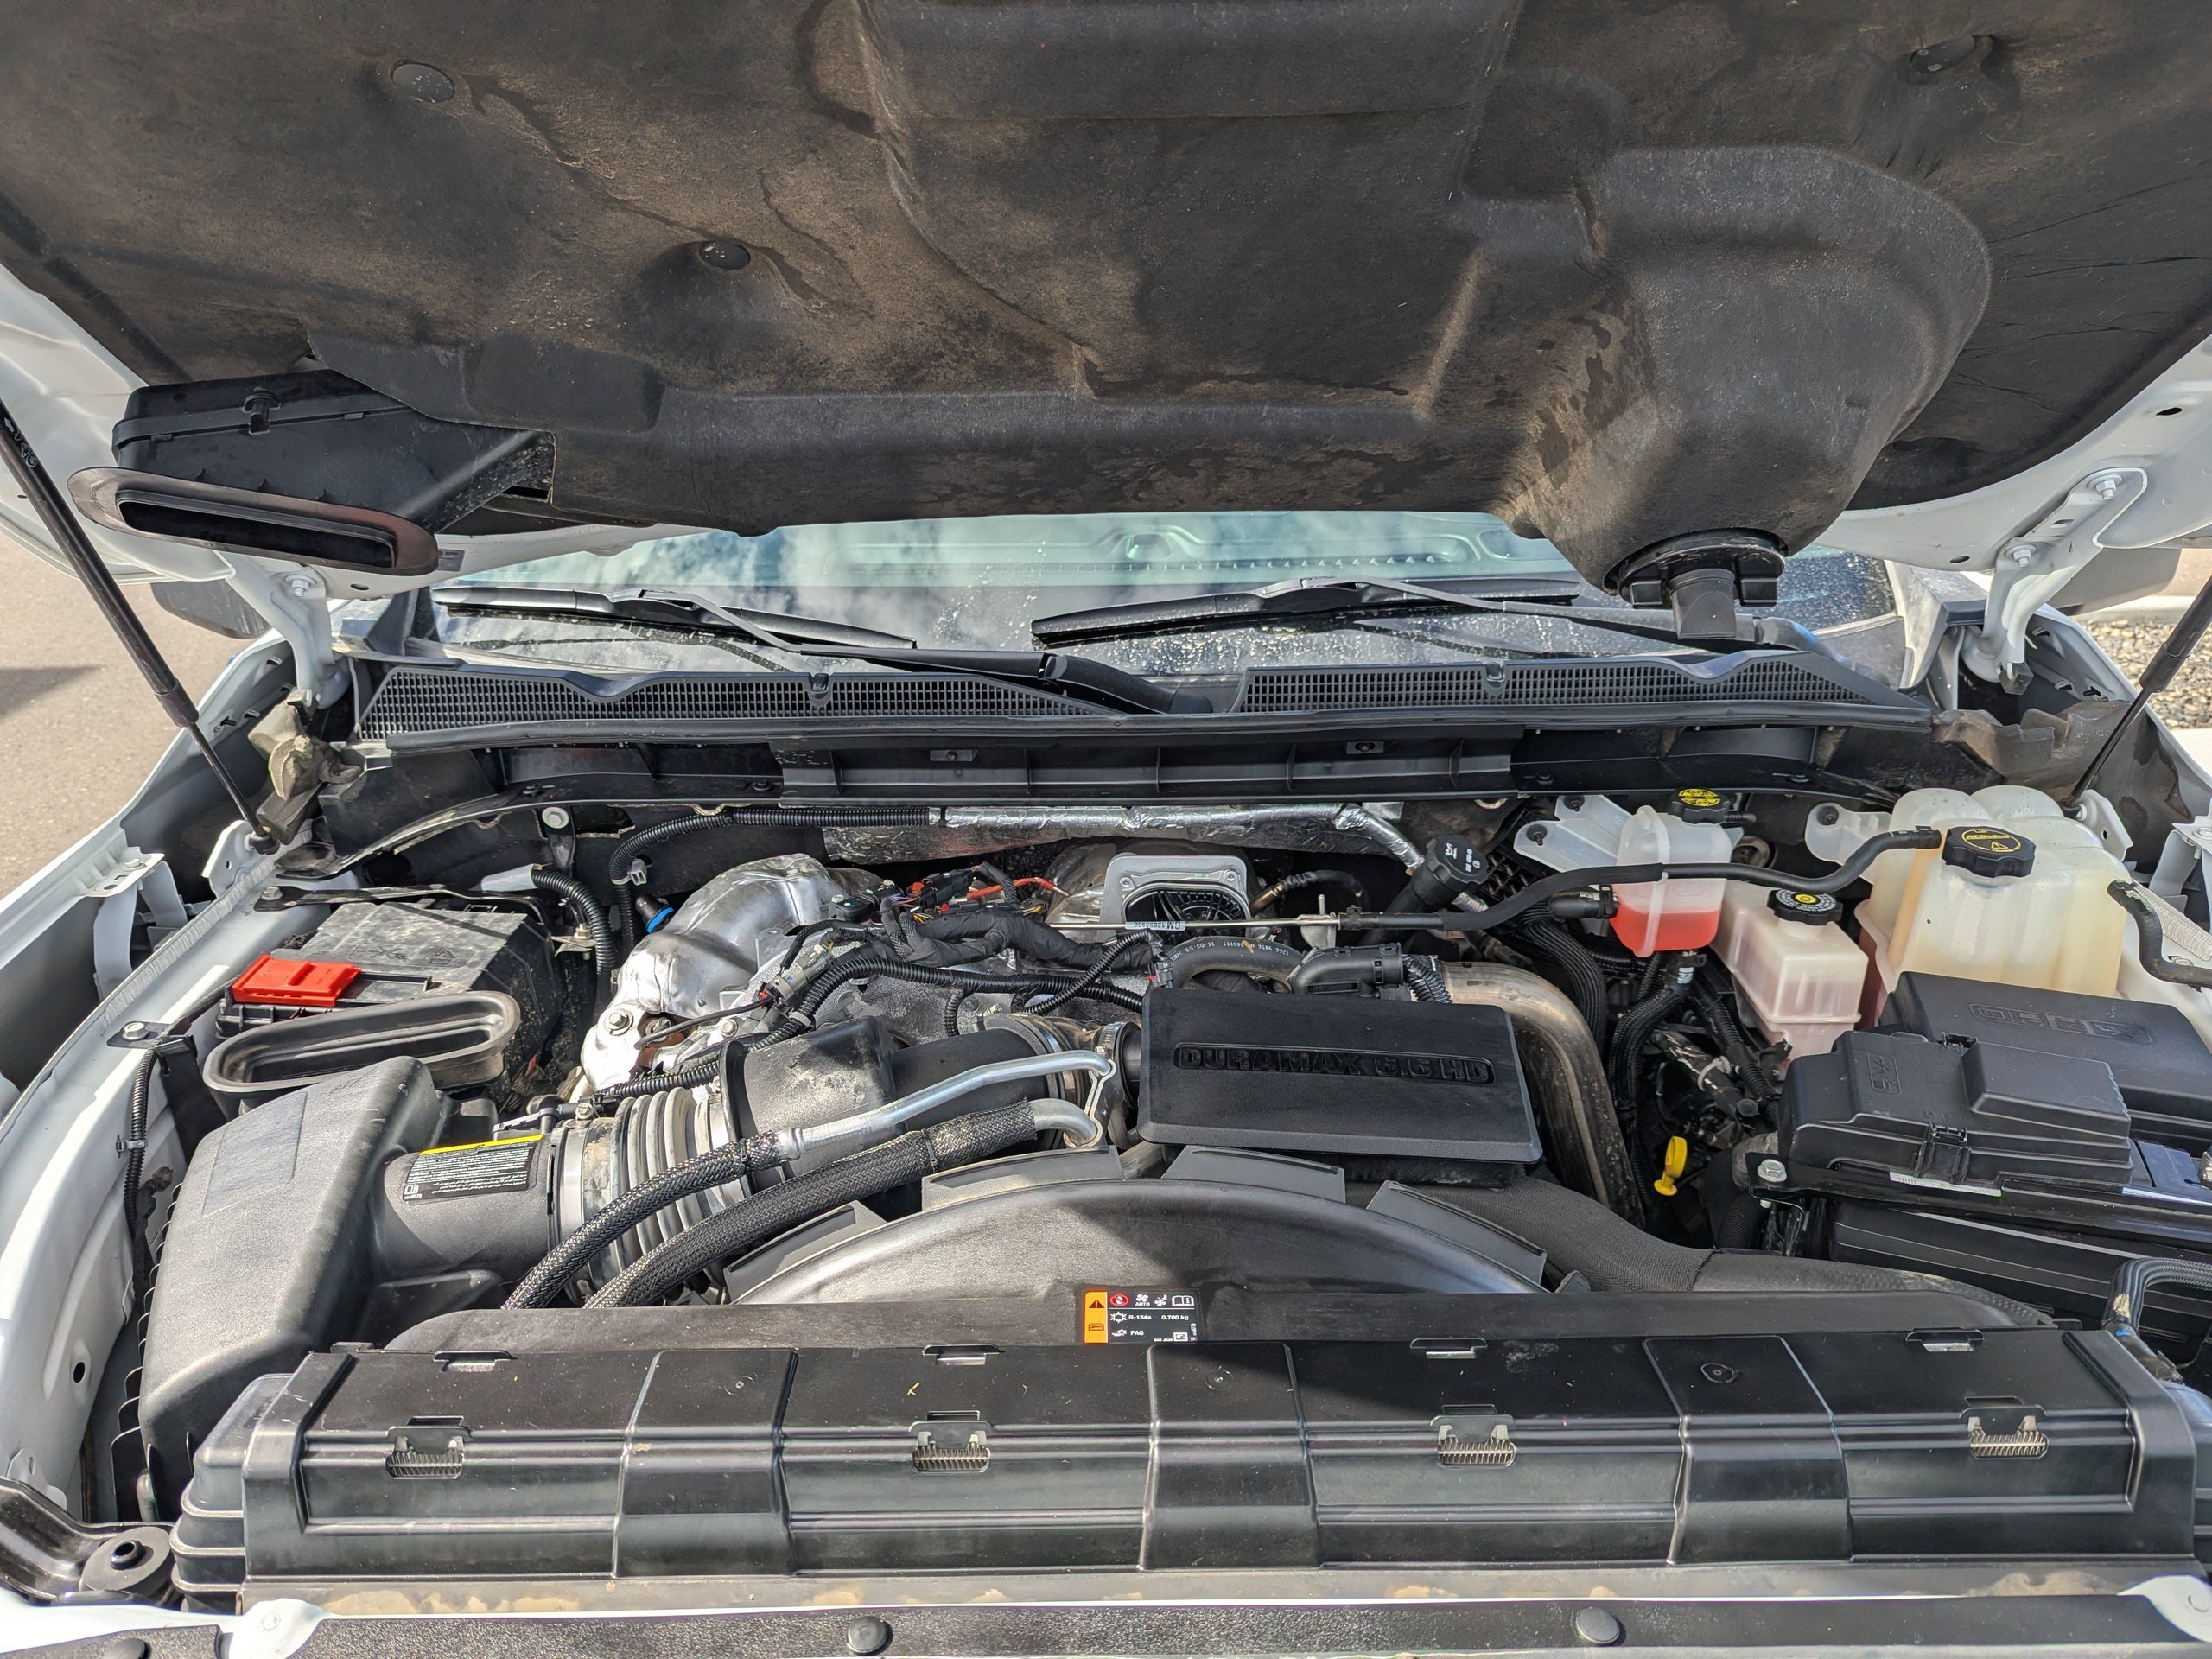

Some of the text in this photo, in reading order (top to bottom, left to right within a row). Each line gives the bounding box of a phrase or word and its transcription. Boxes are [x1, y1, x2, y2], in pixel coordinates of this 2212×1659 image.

[1166, 921, 1180, 930] GM
[1179, 1047, 1491, 1084] DURAMAX 6.6 HD
